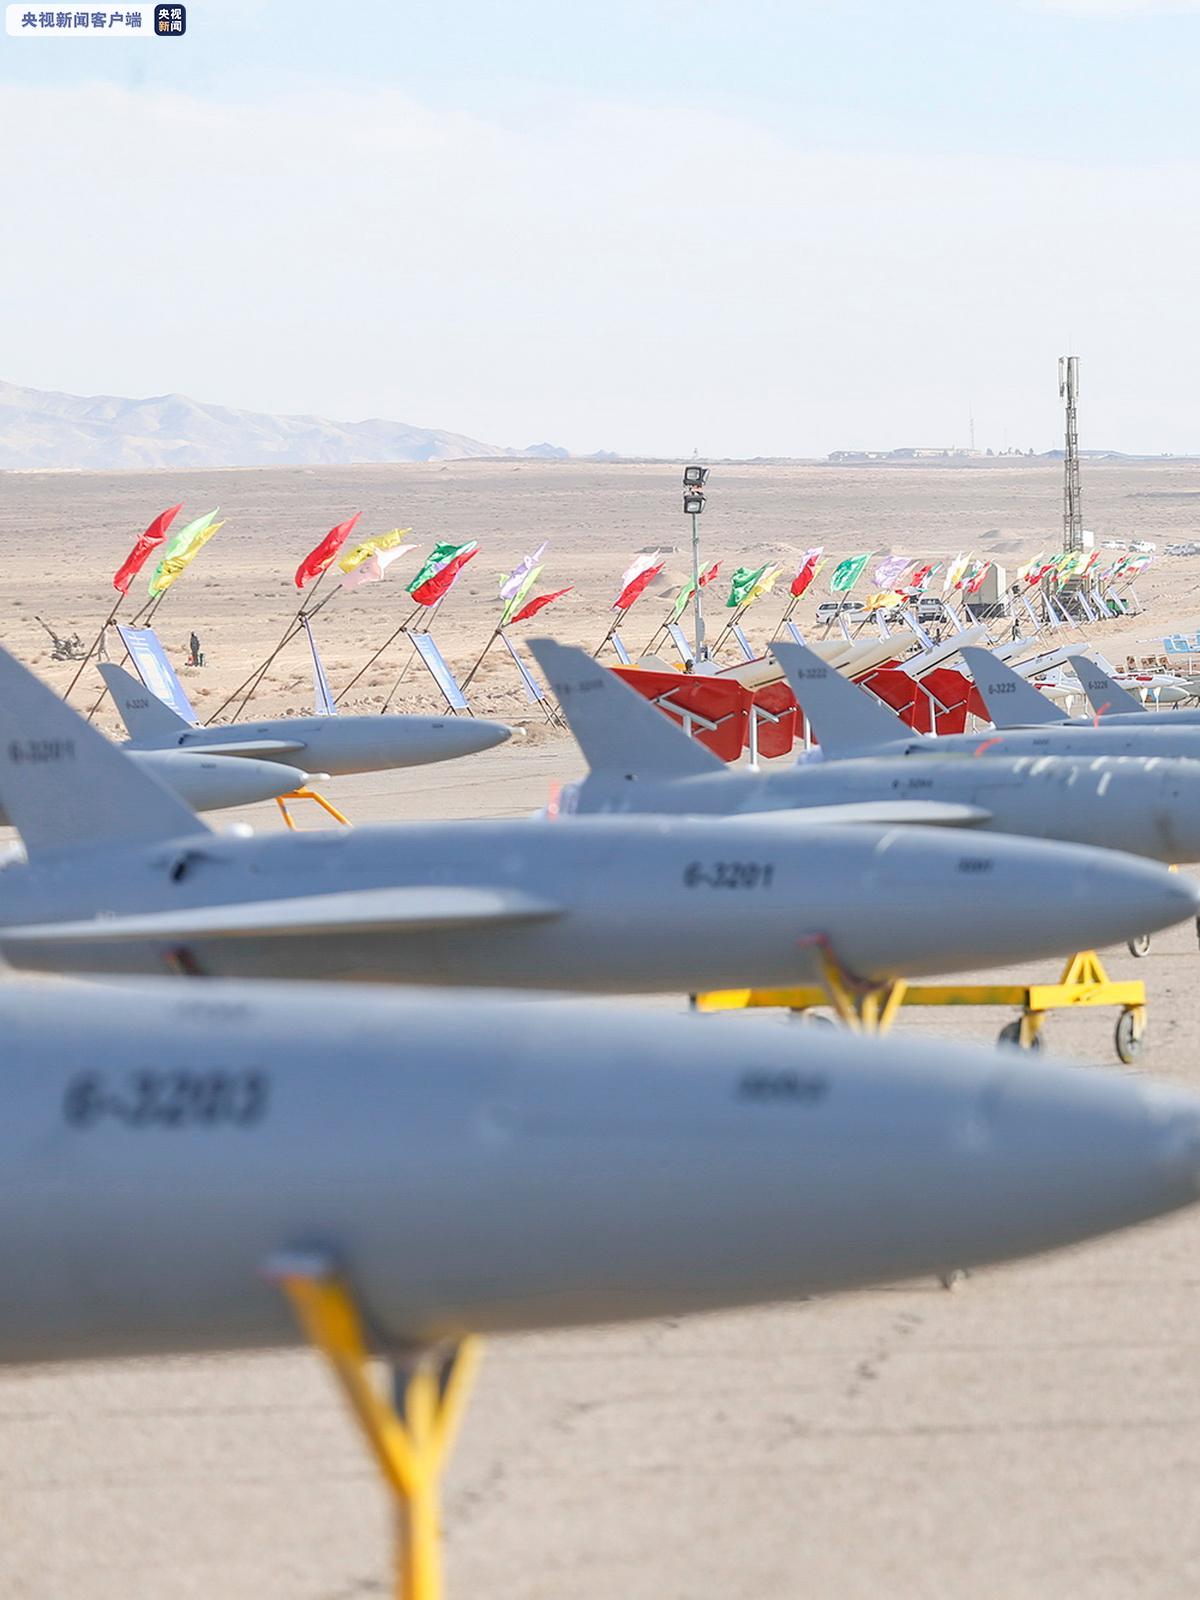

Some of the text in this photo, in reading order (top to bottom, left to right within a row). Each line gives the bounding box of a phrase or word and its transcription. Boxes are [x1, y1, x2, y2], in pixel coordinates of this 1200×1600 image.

[988, 683, 1016, 694] 6-3225
[682, 861, 775, 890] 6-3201
[63, 1067, 272, 1131] 6-3203
